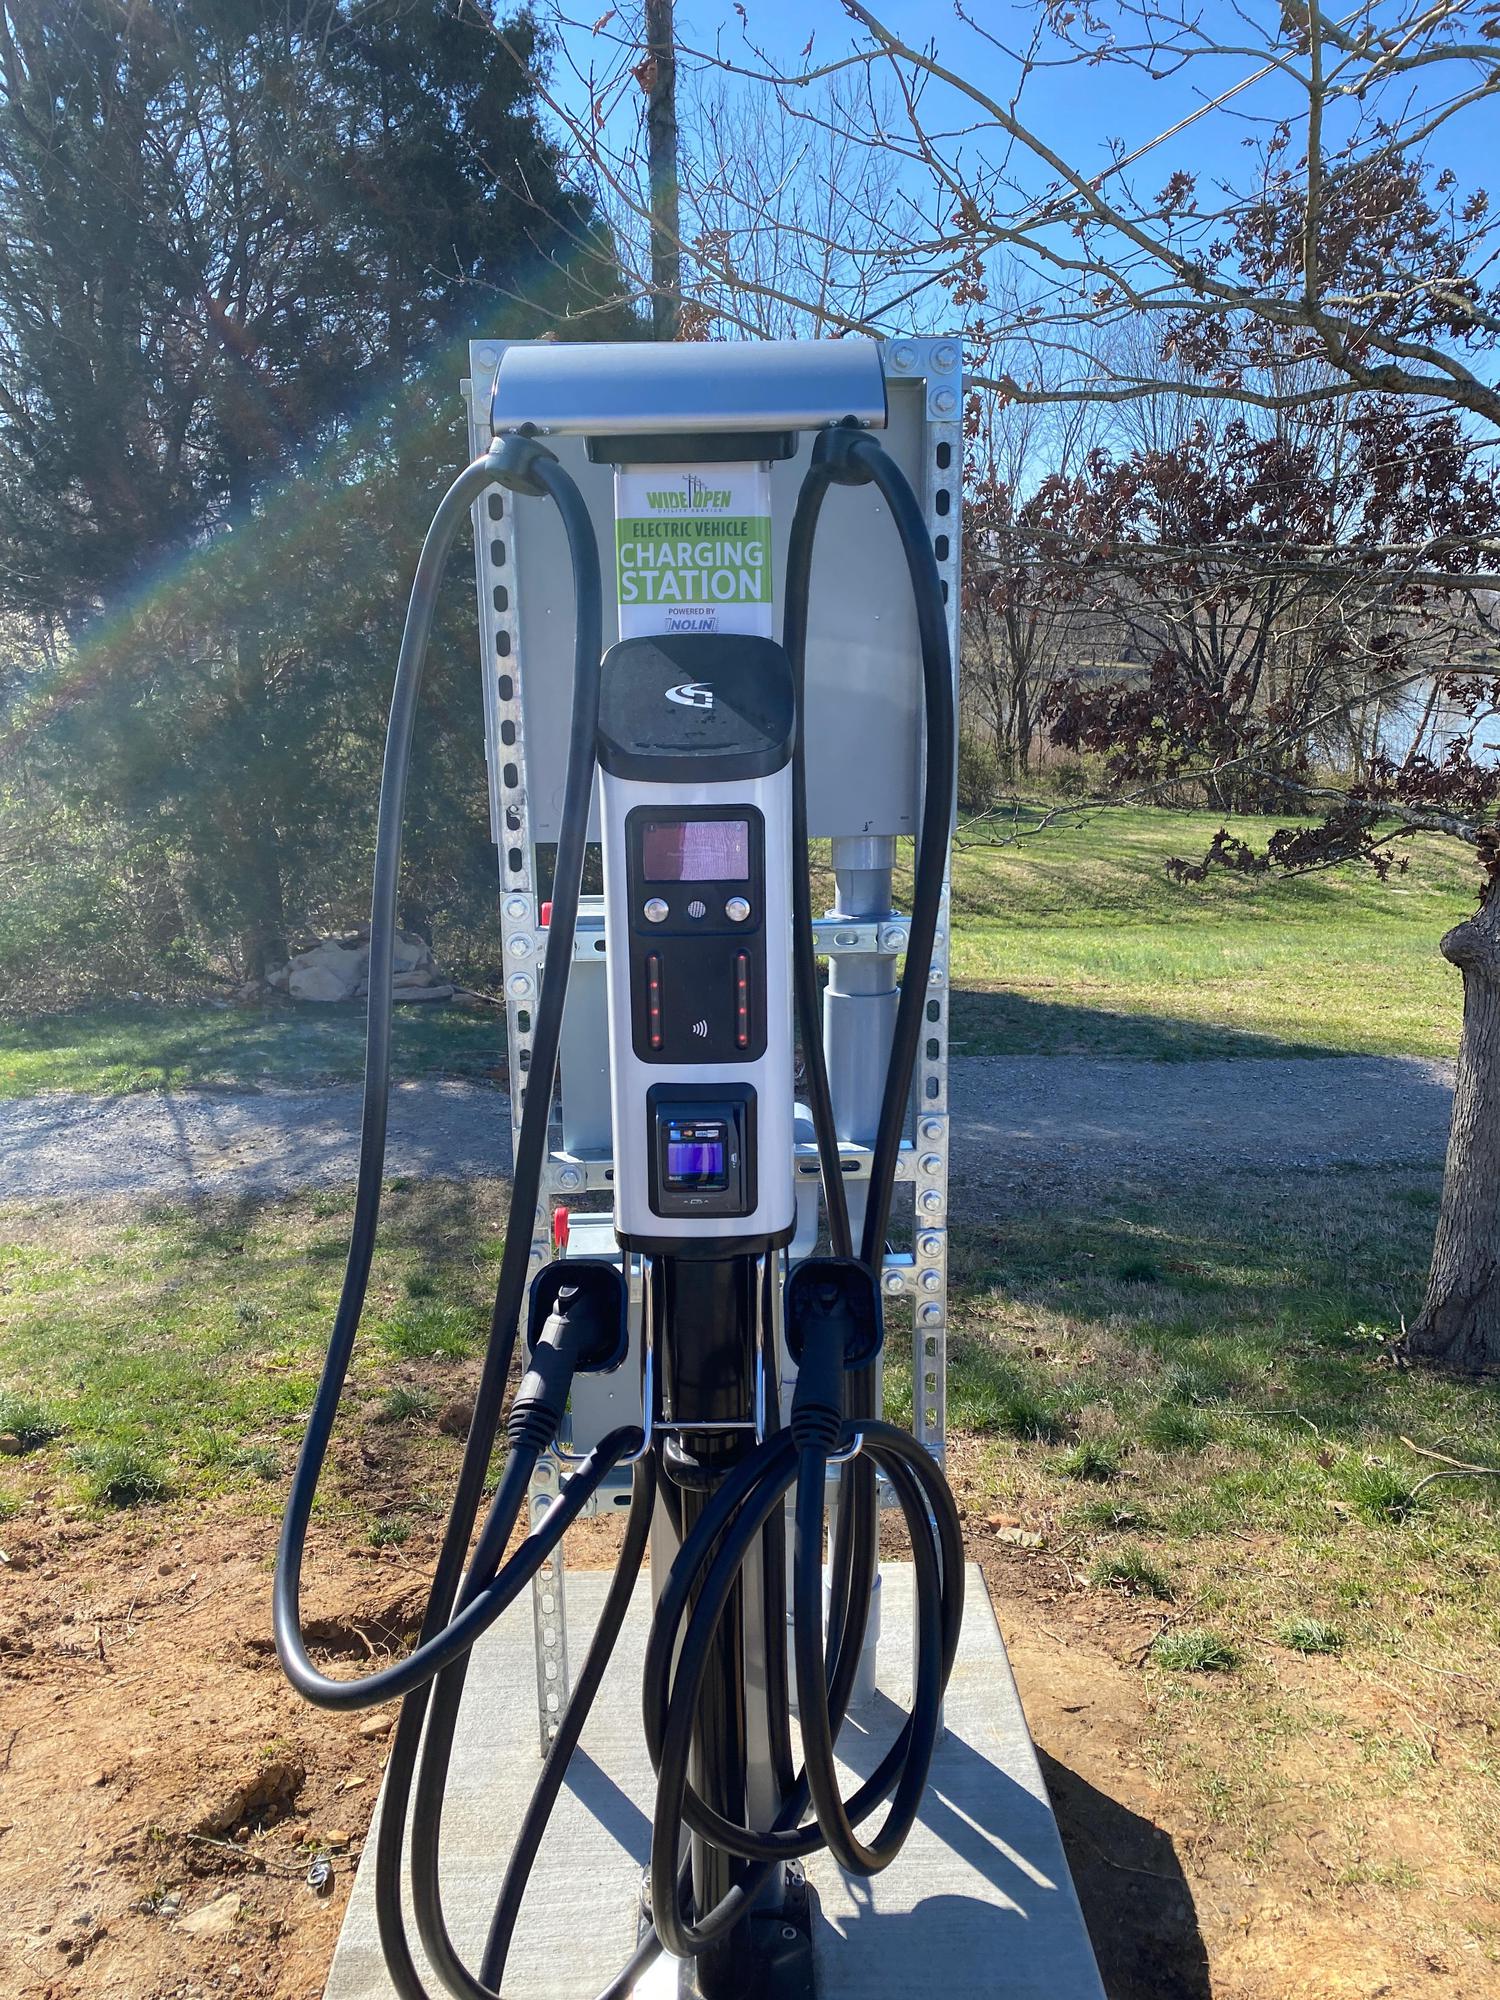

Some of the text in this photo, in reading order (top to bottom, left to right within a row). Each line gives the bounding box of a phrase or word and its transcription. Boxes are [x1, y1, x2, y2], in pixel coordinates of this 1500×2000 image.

[646, 490, 732, 508] WIDE OPEN
[633, 521, 748, 538] ELECTRIC VEHICLE
[620, 541, 763, 568] CHARGING
[621, 569, 762, 601] STATION
[668, 607, 705, 615] POWERED
[671, 619, 713, 630] NOLIN
